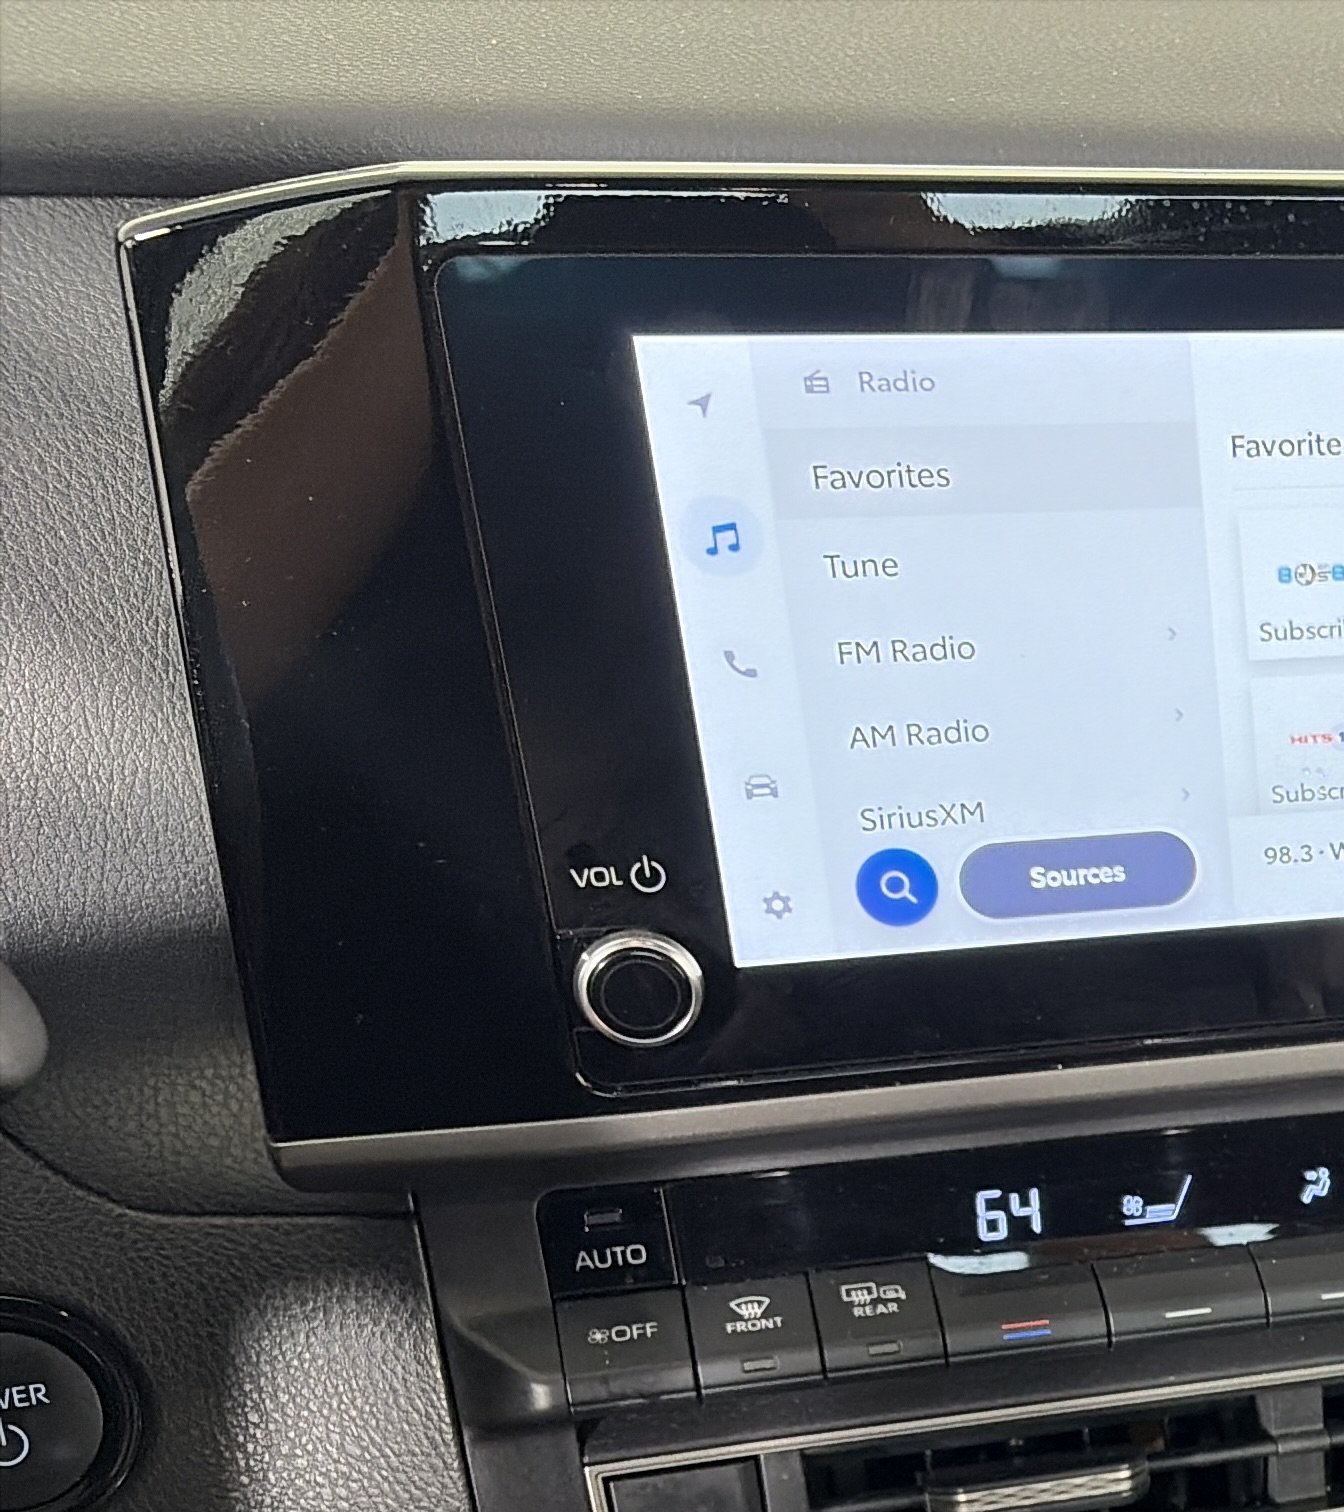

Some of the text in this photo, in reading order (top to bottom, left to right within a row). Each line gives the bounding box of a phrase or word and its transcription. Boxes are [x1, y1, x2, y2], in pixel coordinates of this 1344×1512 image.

[857, 370, 937, 395] Radio
[811, 461, 951, 491] Favorites
[823, 553, 900, 580] Tune
[837, 636, 977, 666] FM Radio
[848, 719, 991, 751] AM Radio
[1290, 732, 1333, 745] HITS
[859, 800, 986, 832] SiriusXM
[1262, 842, 1315, 865] 98.3
[569, 866, 624, 888] VOL
[1029, 863, 1127, 891] Sources
[974, 1187, 1042, 1242] 64
[574, 1243, 648, 1272] AUTO
[852, 1300, 901, 1318] REAR
[610, 1321, 660, 1345] OFF
[724, 1315, 784, 1334] FRONT
